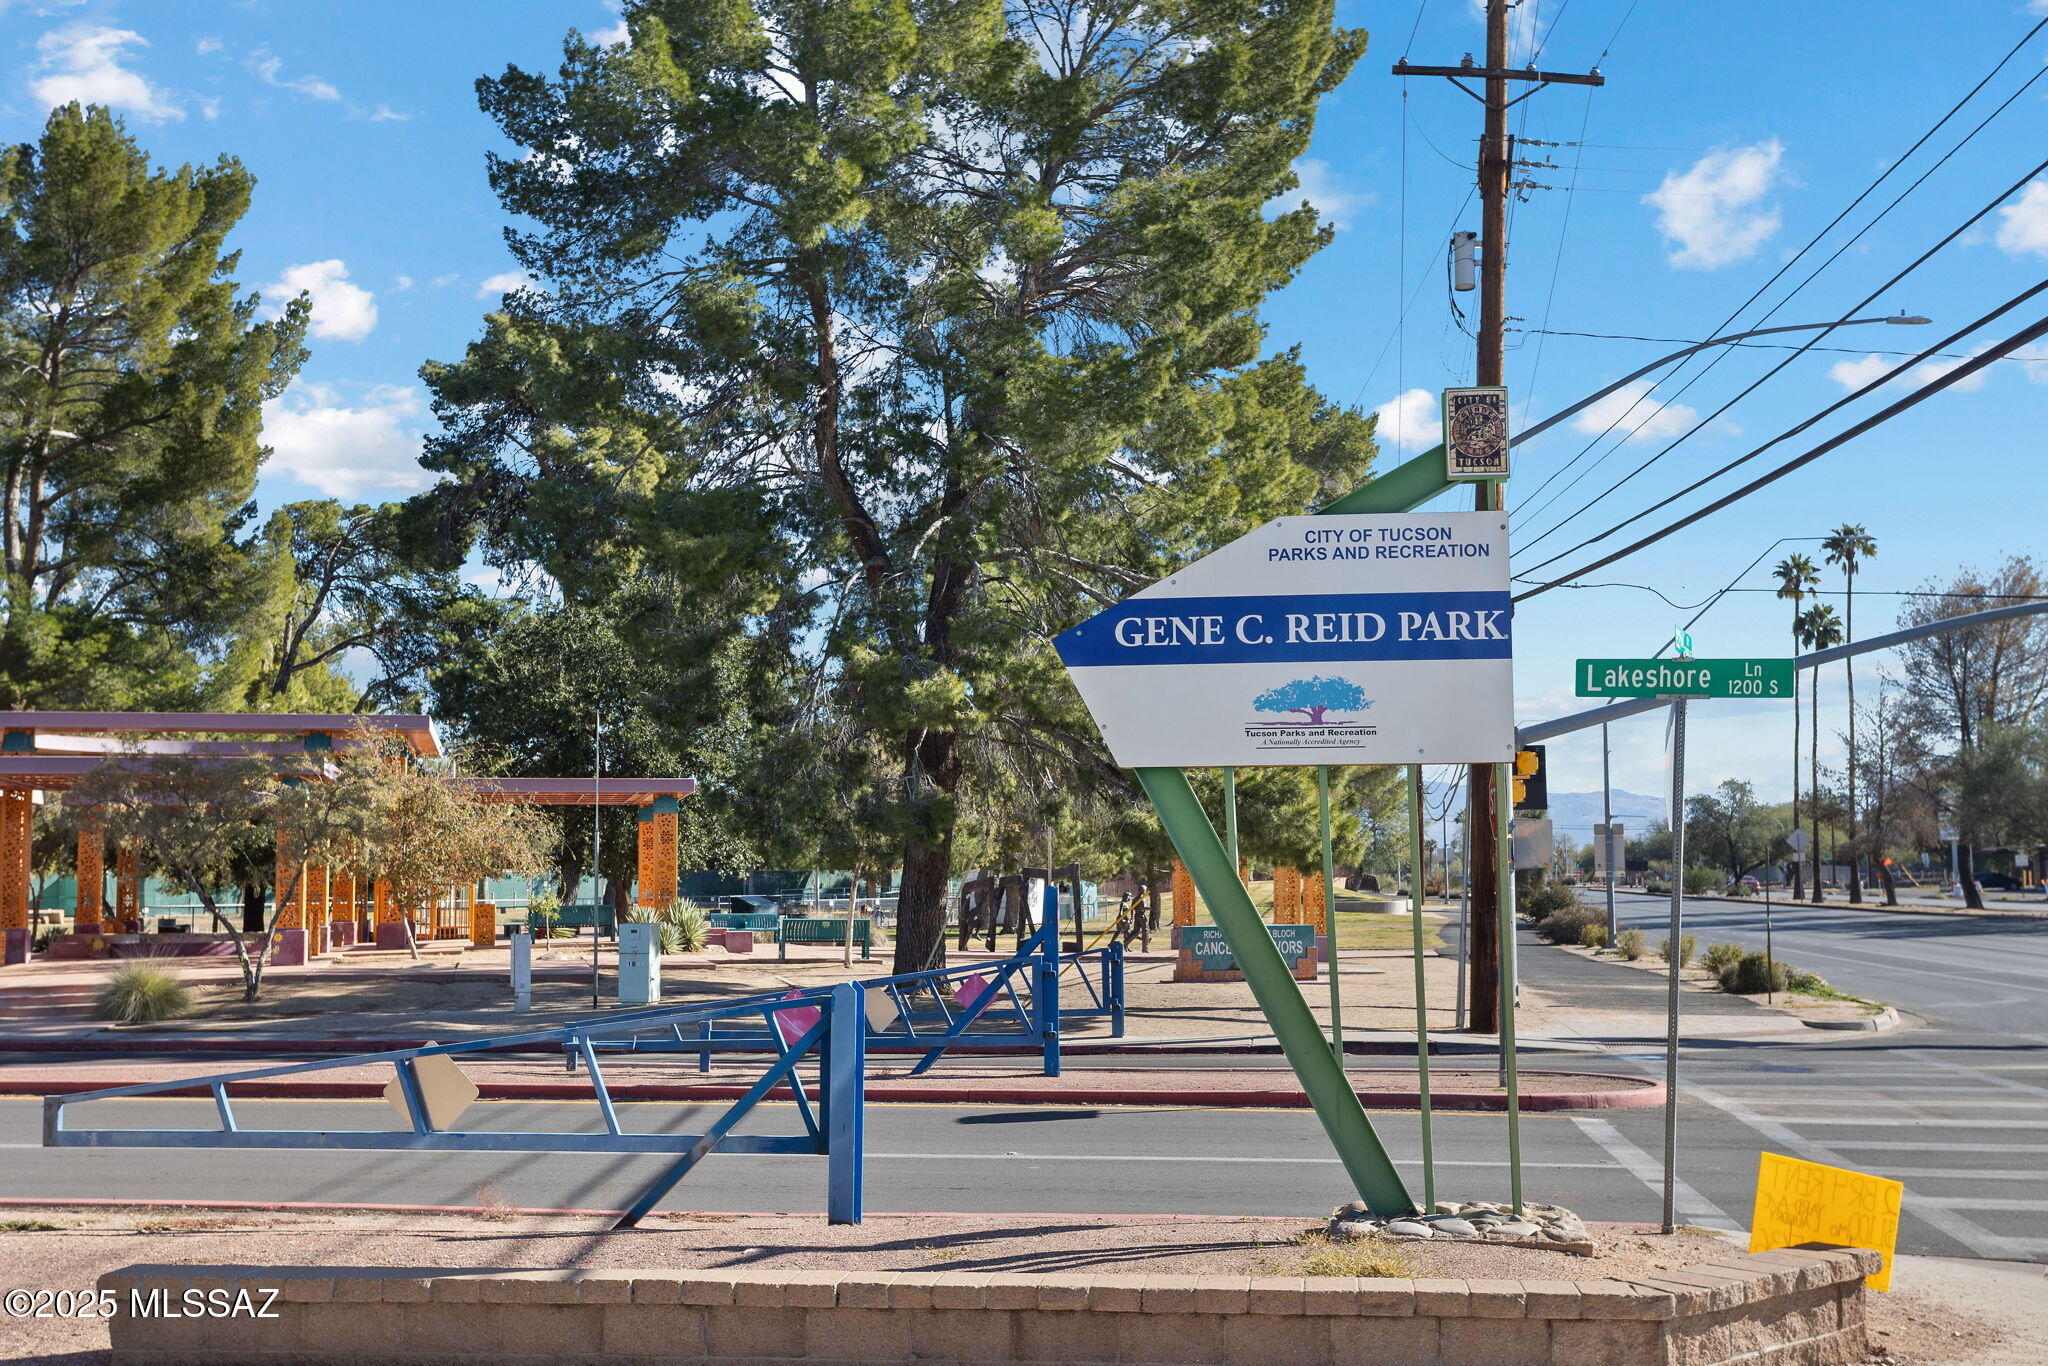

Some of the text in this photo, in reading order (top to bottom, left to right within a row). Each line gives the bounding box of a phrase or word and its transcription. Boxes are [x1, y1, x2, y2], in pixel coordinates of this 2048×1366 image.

[1459, 458, 1500, 466] TUCSON
[1305, 527, 1452, 544] CITY OF TUCSON
[1268, 543, 1490, 561] PARKS AND RECREATION
[1114, 610, 1506, 647] GENE C. REID PARK
[1587, 662, 1762, 692] Lakeshore Ln
[1728, 680, 1779, 695] 1200 S
[1203, 930, 1223, 939] RICH
[1272, 929, 1295, 938] BLOCH
[1195, 942, 1232, 955] CANCE
